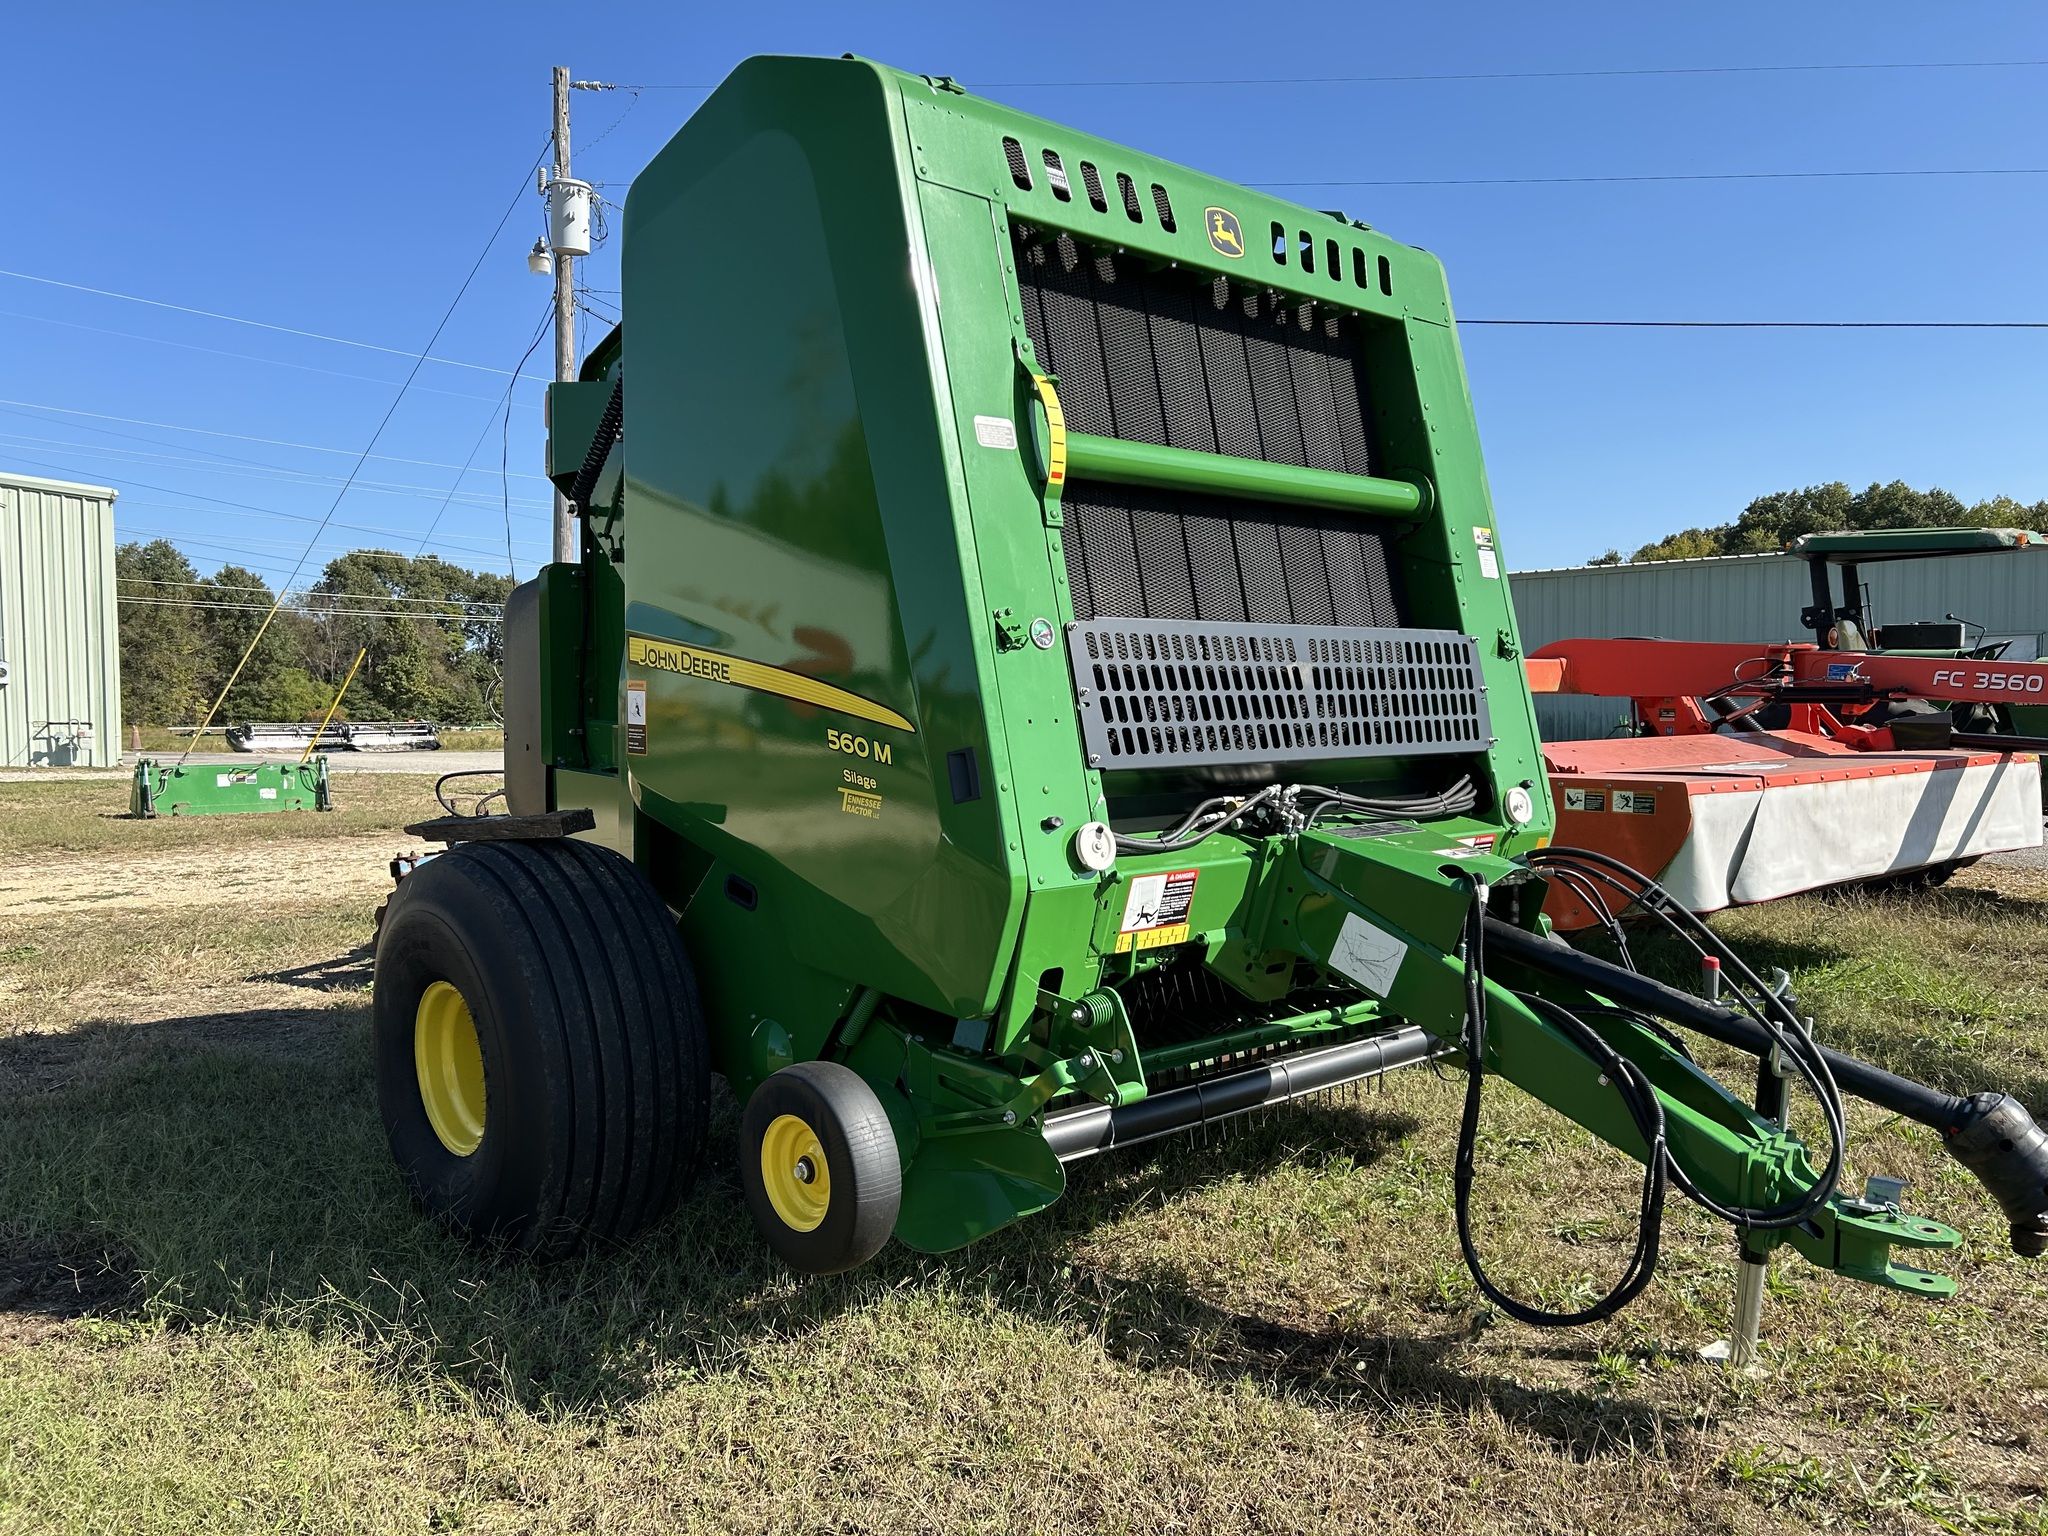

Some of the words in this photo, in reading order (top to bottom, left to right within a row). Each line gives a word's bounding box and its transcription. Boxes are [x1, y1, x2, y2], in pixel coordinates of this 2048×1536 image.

[640, 644, 678, 670] JOHN
[681, 650, 731, 682] DEERE
[1932, 670, 1966, 688] FC
[1973, 672, 2044, 692] 3560
[827, 728, 870, 758] 560
[873, 740, 893, 766] M
[843, 769, 877, 790] Silage
[837, 786, 882, 810] TENNESSEE
